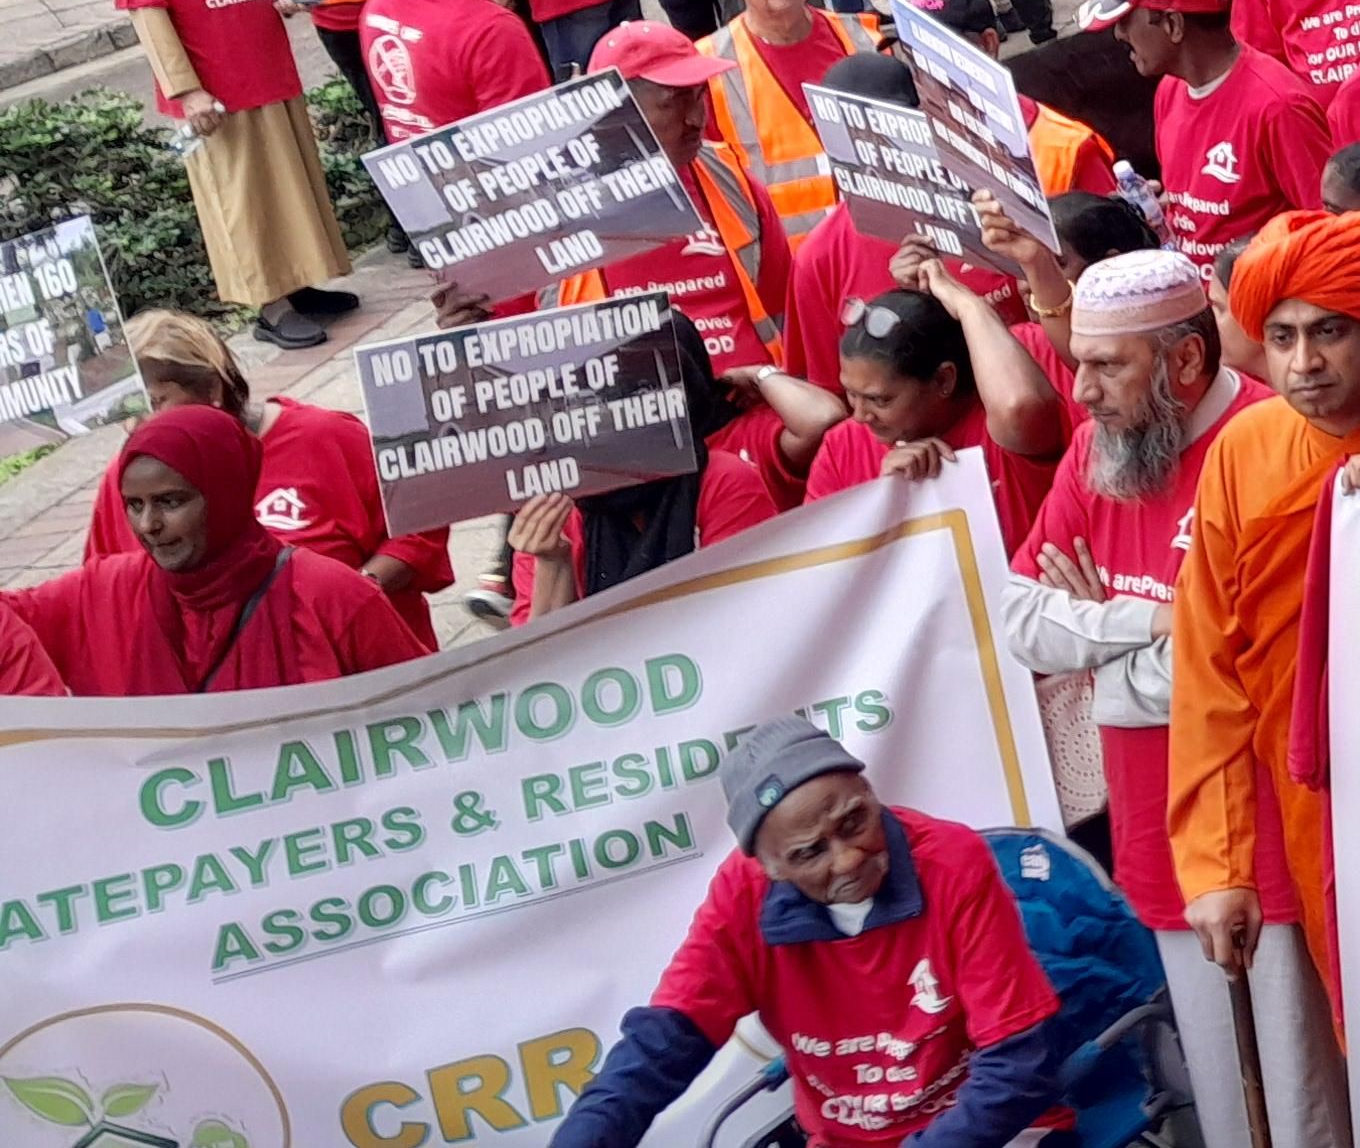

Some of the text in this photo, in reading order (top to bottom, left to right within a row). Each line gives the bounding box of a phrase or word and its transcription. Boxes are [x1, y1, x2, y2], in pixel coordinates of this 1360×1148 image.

[1323, 10, 1343, 25] are
[1326, 43, 1356, 61] OUR
[1333, 27, 1348, 40] To
[377, 155, 420, 190] NO
[416, 139, 455, 175] TO
[451, 79, 623, 161] EXPROPIATION
[442, 133, 600, 213] OF PEOPLE OF
[418, 153, 675, 271] CLAIRWOOD OFF THEIR
[534, 229, 603, 275] LAND
[370, 299, 662, 387] NO TO EXPROPIATION
[431, 354, 620, 423] OF PEOPLE OF
[377, 387, 686, 482] CLAIRWOOD OFF THEIR
[505, 456, 581, 501] LAND
[137, 651, 706, 832] CLAIRWOOD
[0, 686, 897, 954] ATEPAYERS & RESIDTS
[210, 810, 694, 975] ASSOCIATION
[339, 1024, 603, 1148] CRR
